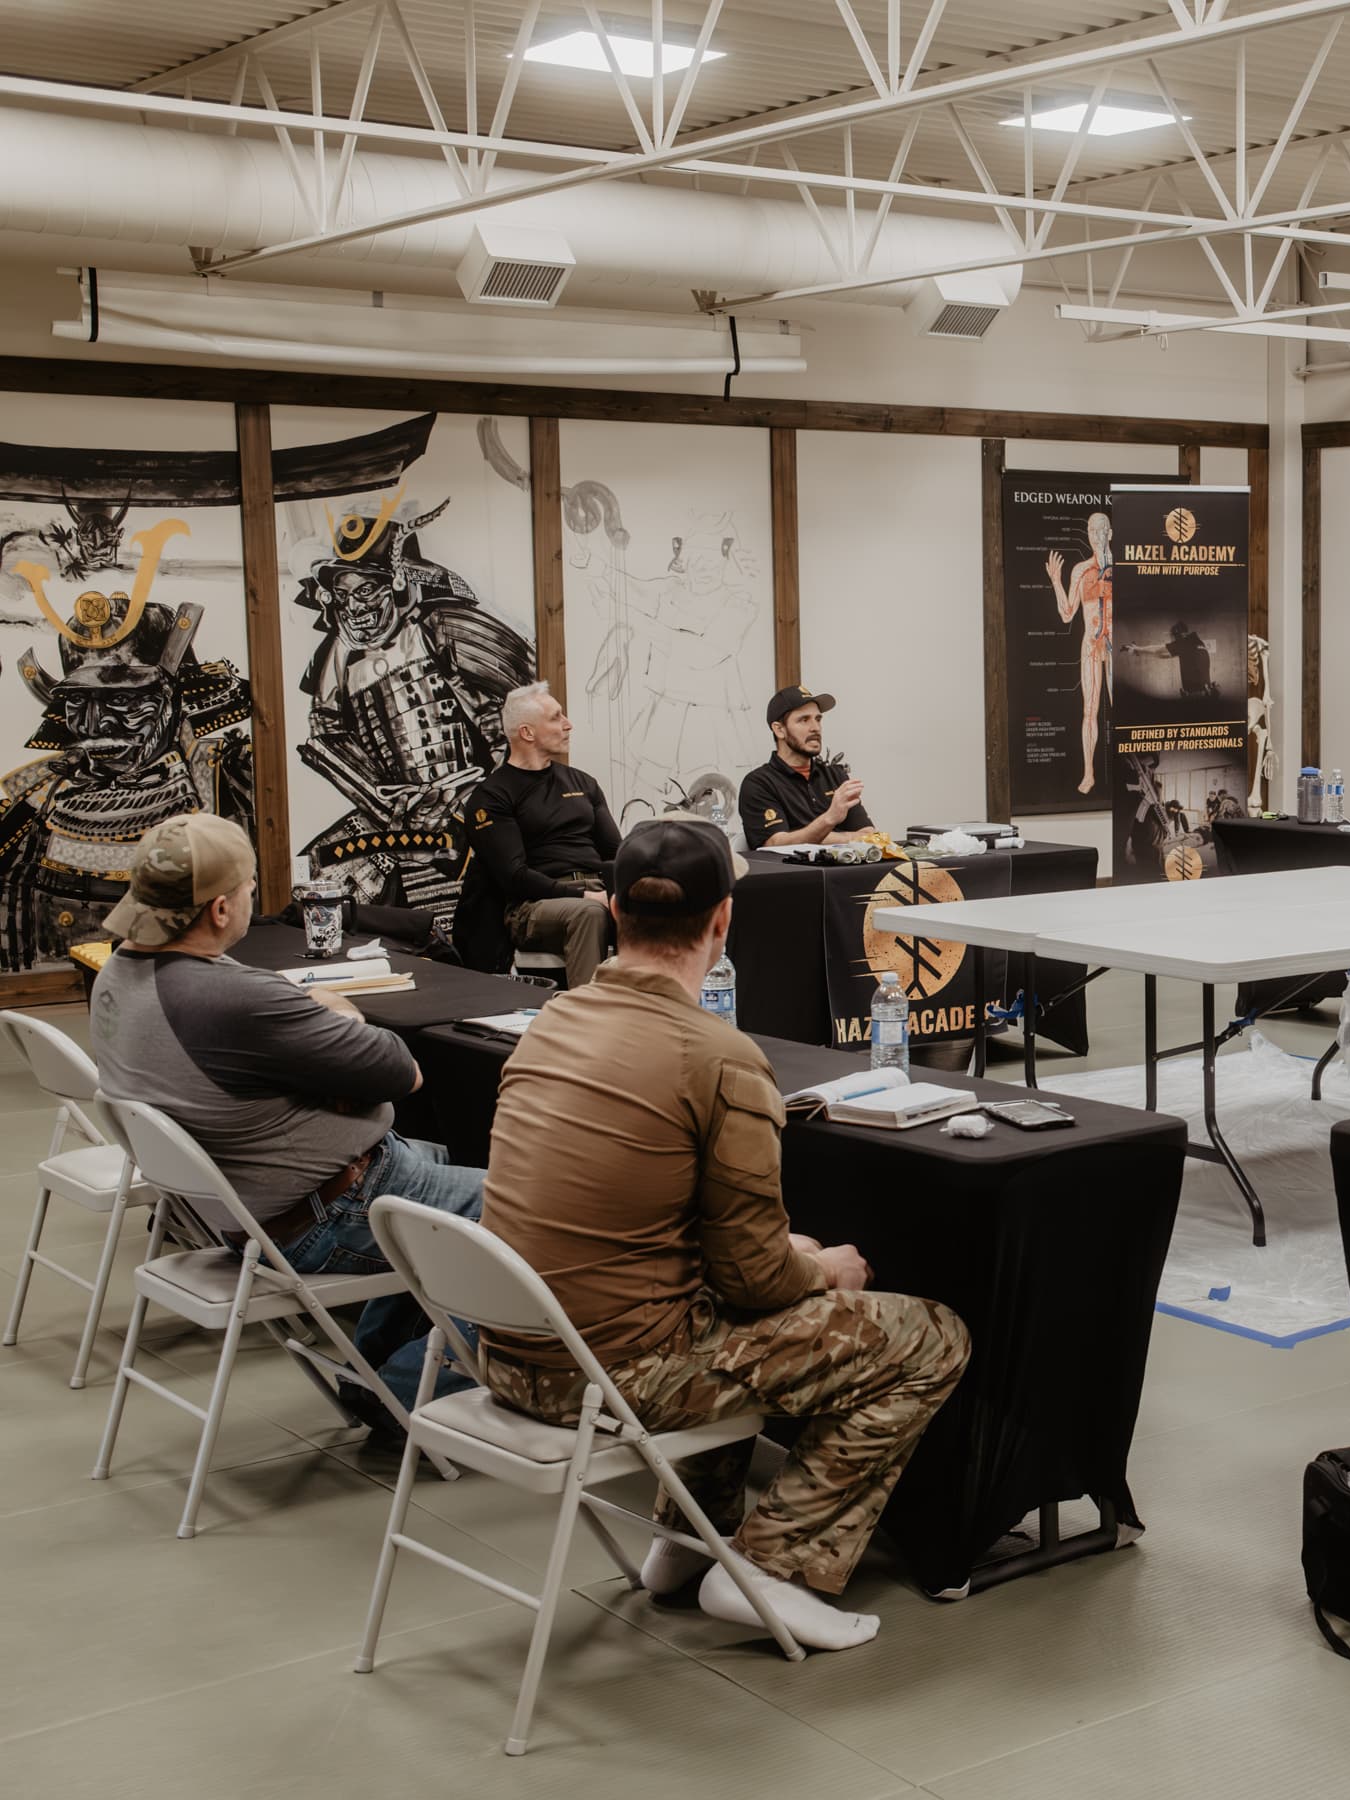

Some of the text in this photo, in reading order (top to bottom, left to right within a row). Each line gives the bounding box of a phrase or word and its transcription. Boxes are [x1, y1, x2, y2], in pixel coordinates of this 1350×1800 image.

[1014, 491, 1053, 504] EDGED
[1055, 493, 1102, 505] WEAPON
[1124, 545, 1236, 562] HAZEL ACADEMY
[1137, 565, 1220, 576] TRAIN WITH PURPOSE
[1131, 726, 1229, 740] DEFINED BY STANDARDS
[1118, 737, 1244, 753] DELIVERED BY PROFESSIONALS
[835, 999, 1001, 1044] HAZ ACADE
